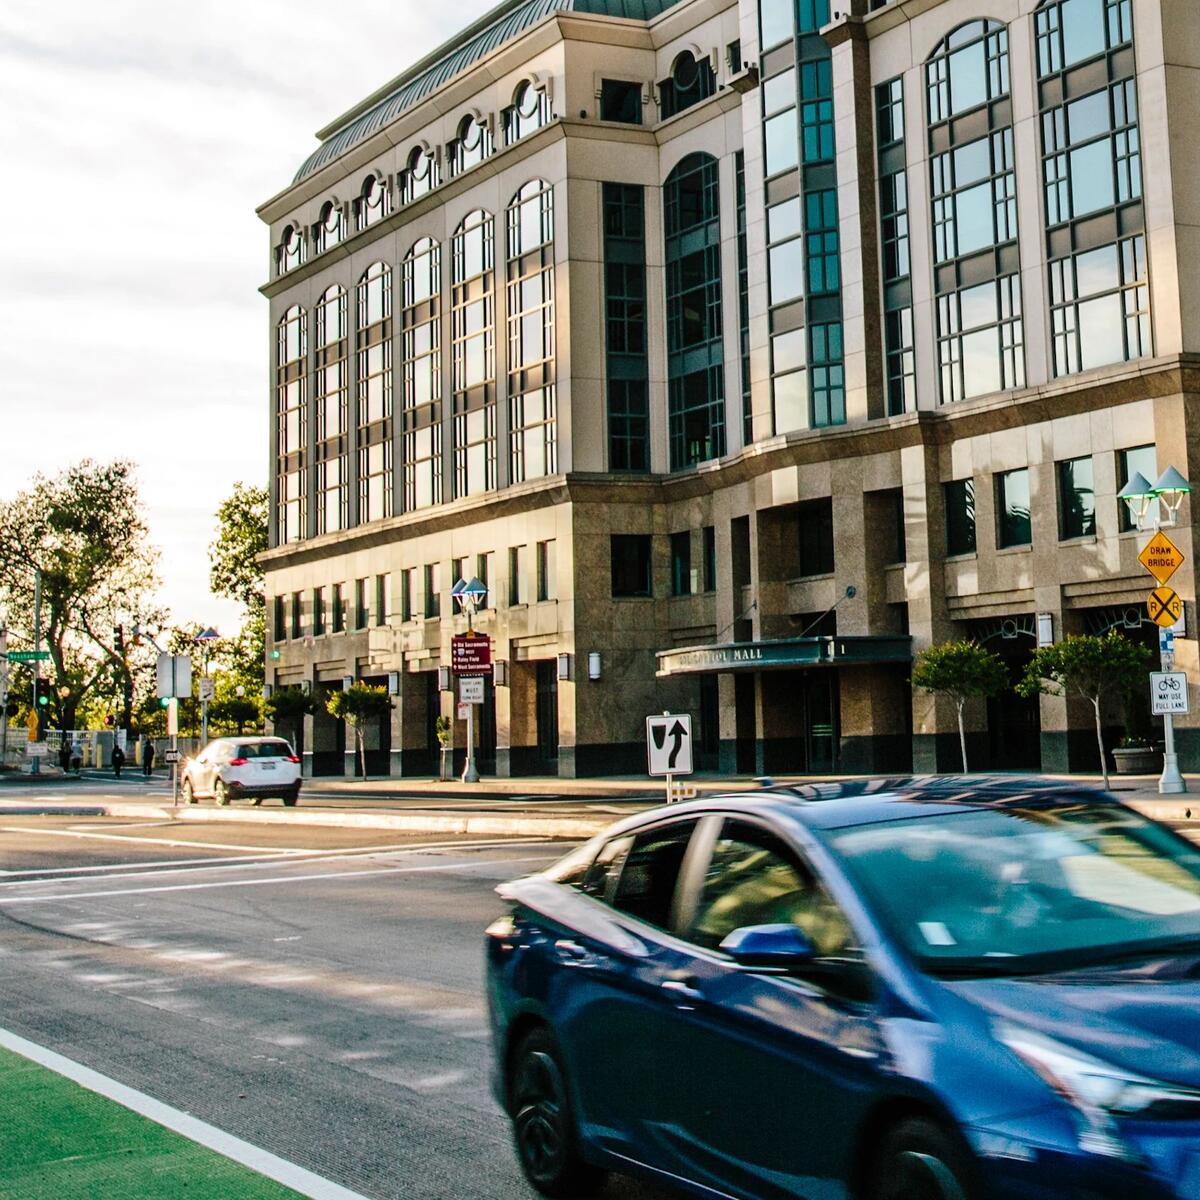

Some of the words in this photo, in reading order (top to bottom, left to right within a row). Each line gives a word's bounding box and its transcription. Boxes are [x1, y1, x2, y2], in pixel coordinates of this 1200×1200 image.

[1150, 546, 1172, 555] DRAW
[1148, 558, 1176, 567] BRIDGE
[1150, 602, 1157, 611] R
[1172, 602, 1179, 611] R
[733, 648, 763, 660] MALL
